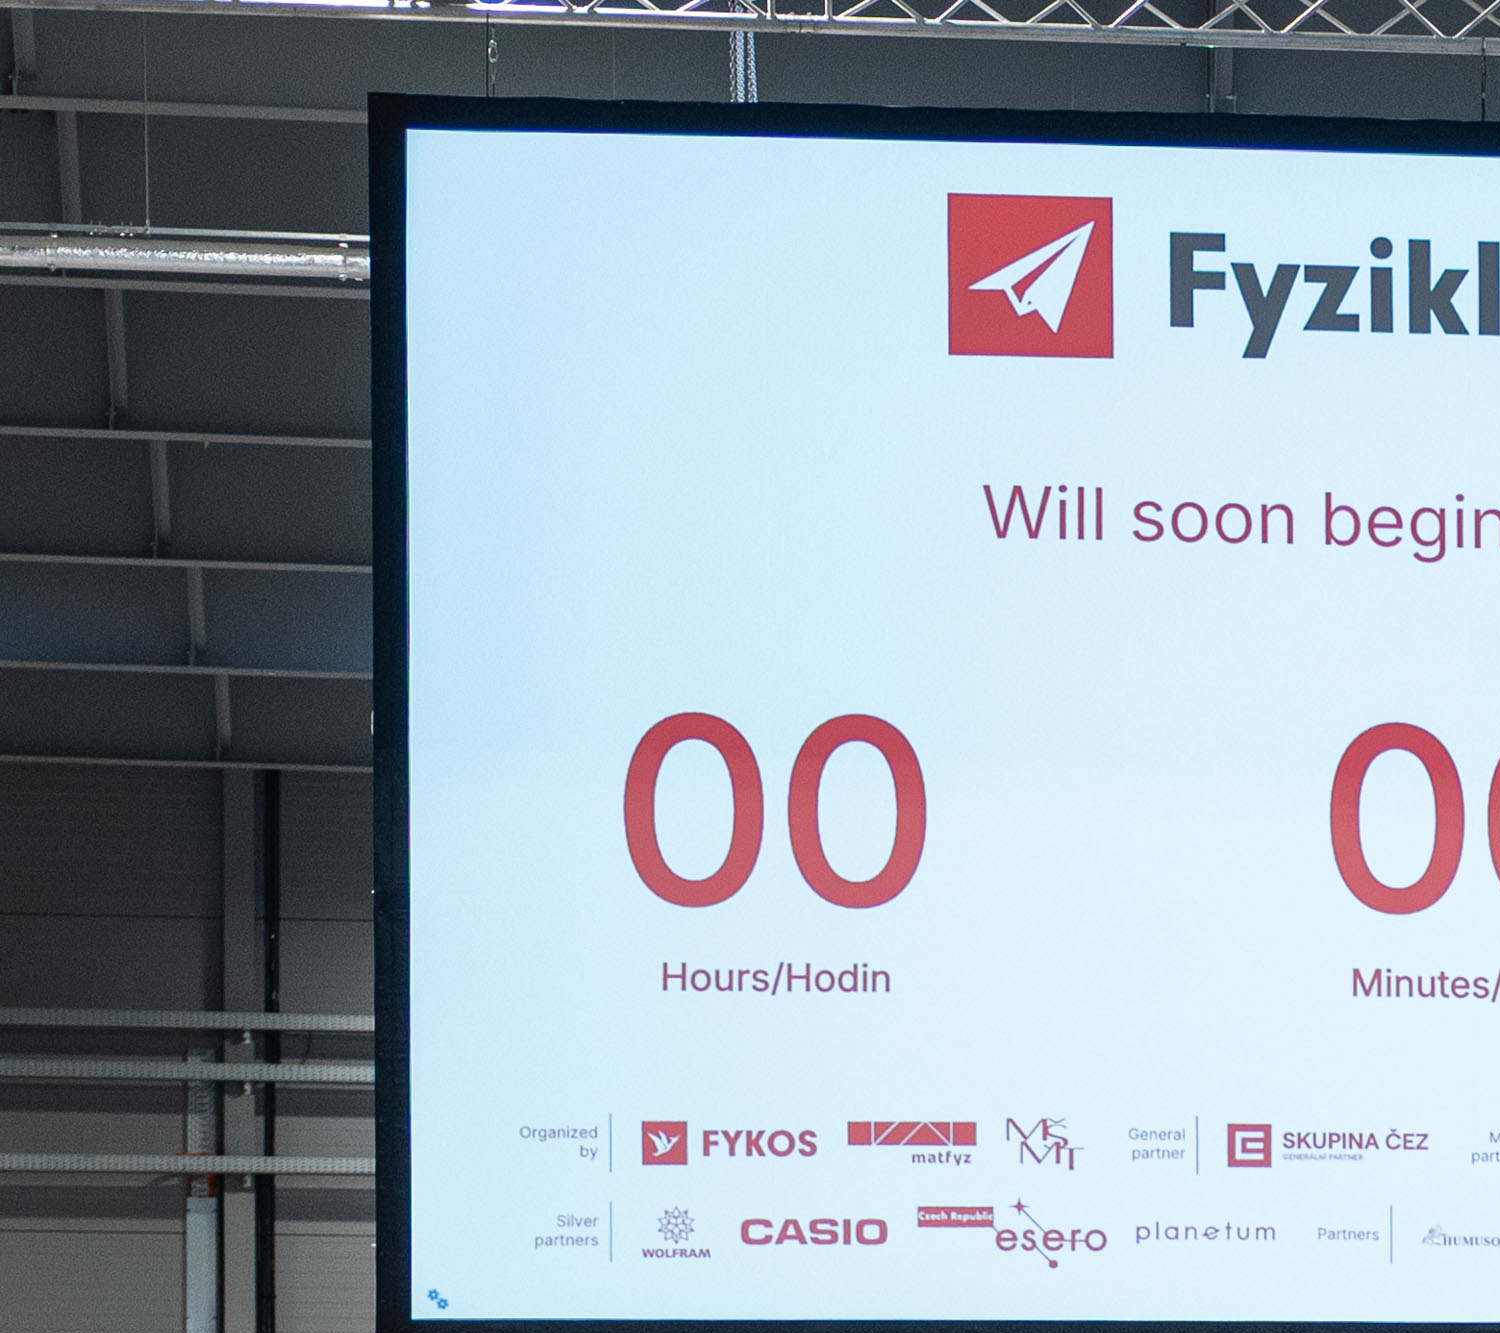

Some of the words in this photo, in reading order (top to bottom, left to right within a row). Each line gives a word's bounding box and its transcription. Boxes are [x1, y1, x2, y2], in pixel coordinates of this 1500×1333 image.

[983, 485, 1102, 540] Will
[1133, 501, 1293, 544] soon
[623, 712, 926, 909] 00
[663, 962, 890, 995] Hours/Hodin
[520, 1126, 598, 1142] Organized
[1129, 1128, 1186, 1141] General
[1283, 1132, 1379, 1150] SKUPINA
[1385, 1128, 1429, 1150] ČEZ
[703, 1130, 818, 1157] FYKOS
[580, 1145, 598, 1160] by
[911, 1150, 972, 1167] matfyz
[1132, 1148, 1186, 1162] partner
[557, 1214, 598, 1228] Silver
[919, 1211, 948, 1221] Czech
[741, 1218, 888, 1246] CASIO
[996, 1228, 1107, 1252] esero
[1136, 1221, 1276, 1244] planetum
[1318, 1227, 1380, 1240] Partners
[535, 1235, 598, 1250] partners
[642, 1248, 711, 1259] WOLFRAM
